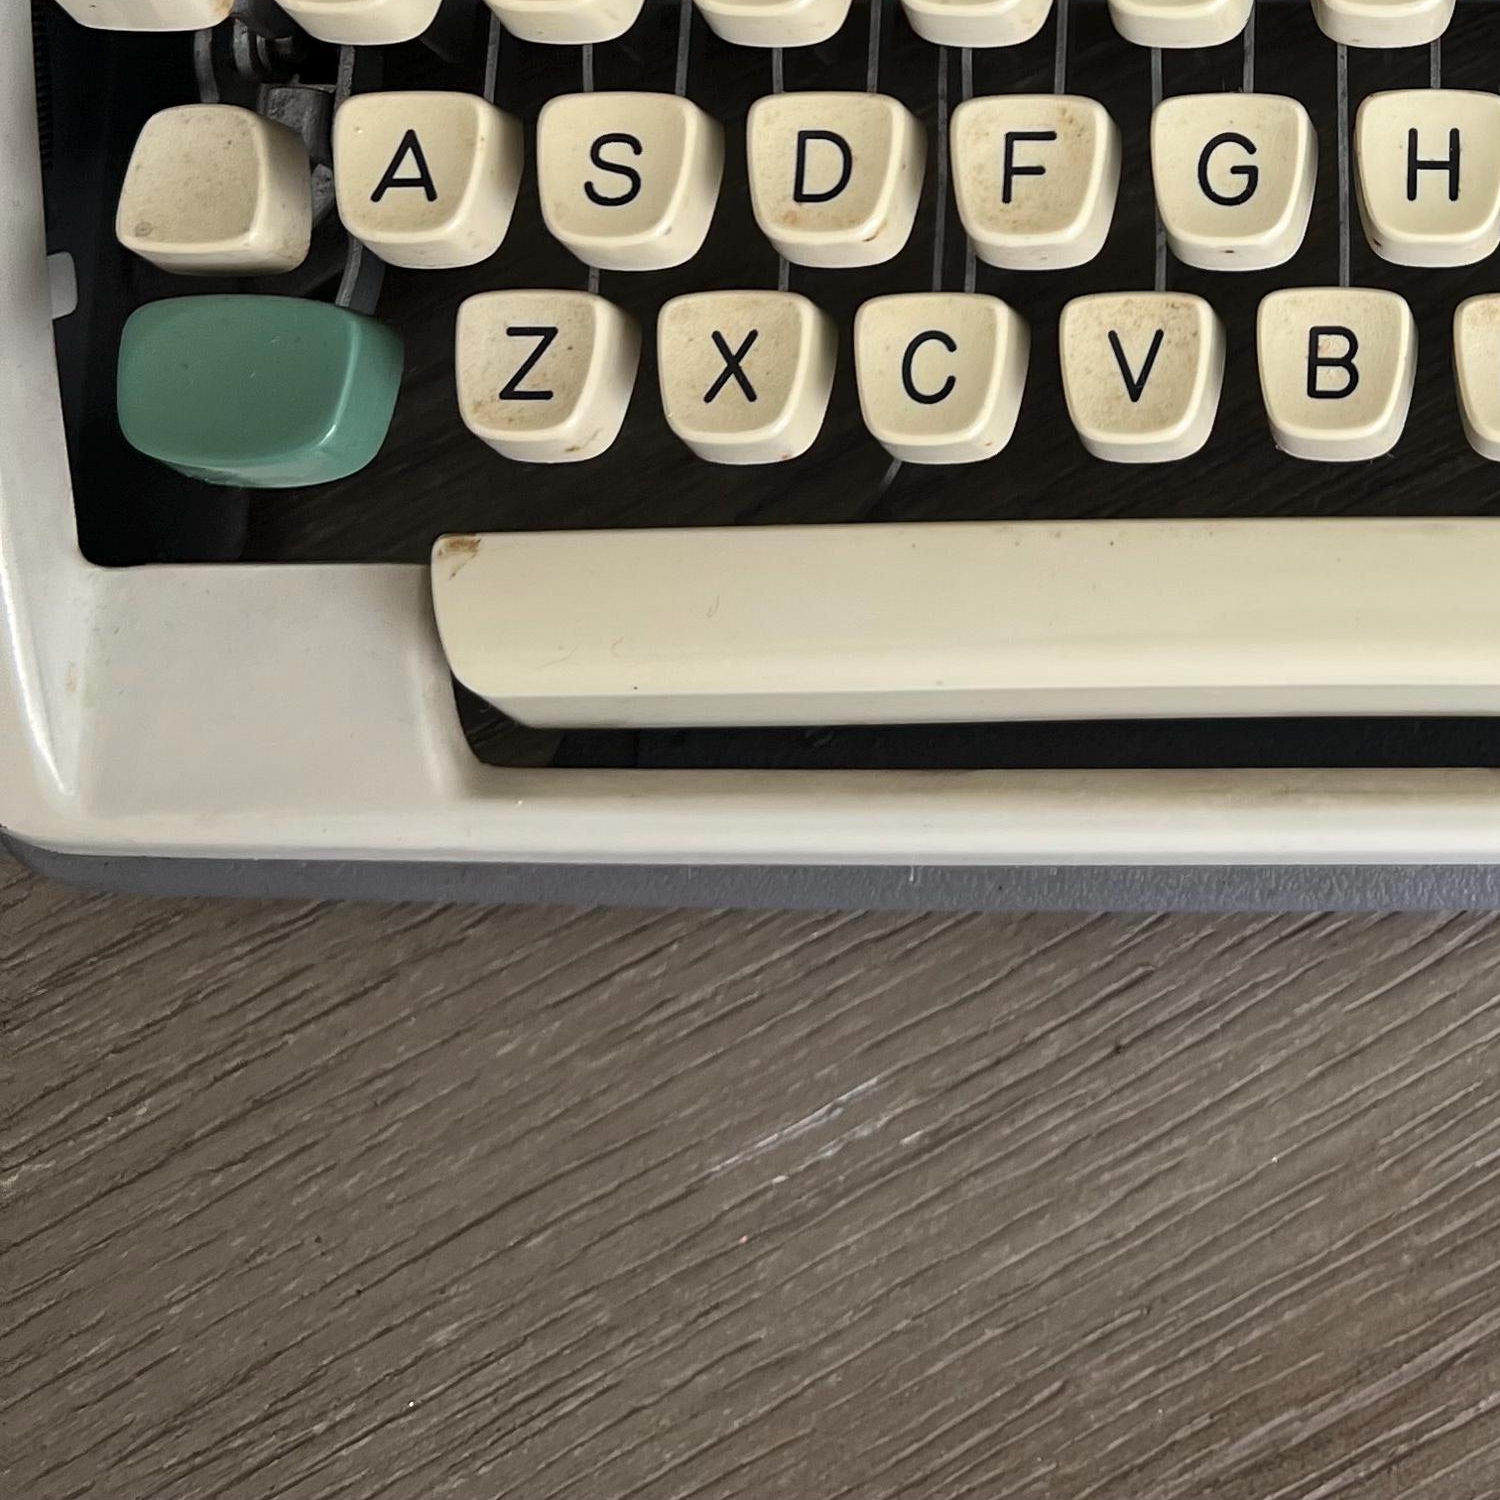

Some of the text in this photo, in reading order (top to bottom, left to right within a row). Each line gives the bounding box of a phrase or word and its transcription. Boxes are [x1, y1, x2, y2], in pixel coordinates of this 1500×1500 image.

[371, 129, 437, 202] A
[584, 133, 642, 206] S
[793, 130, 853, 203] D
[1002, 131, 1057, 204] F
[1198, 132, 1258, 206] G
[1407, 128, 1460, 201] H
[499, 327, 558, 400] Z
[704, 329, 758, 403] X
[902, 330, 957, 404] C
[1108, 329, 1164, 402] V
[1307, 326, 1359, 399] B
